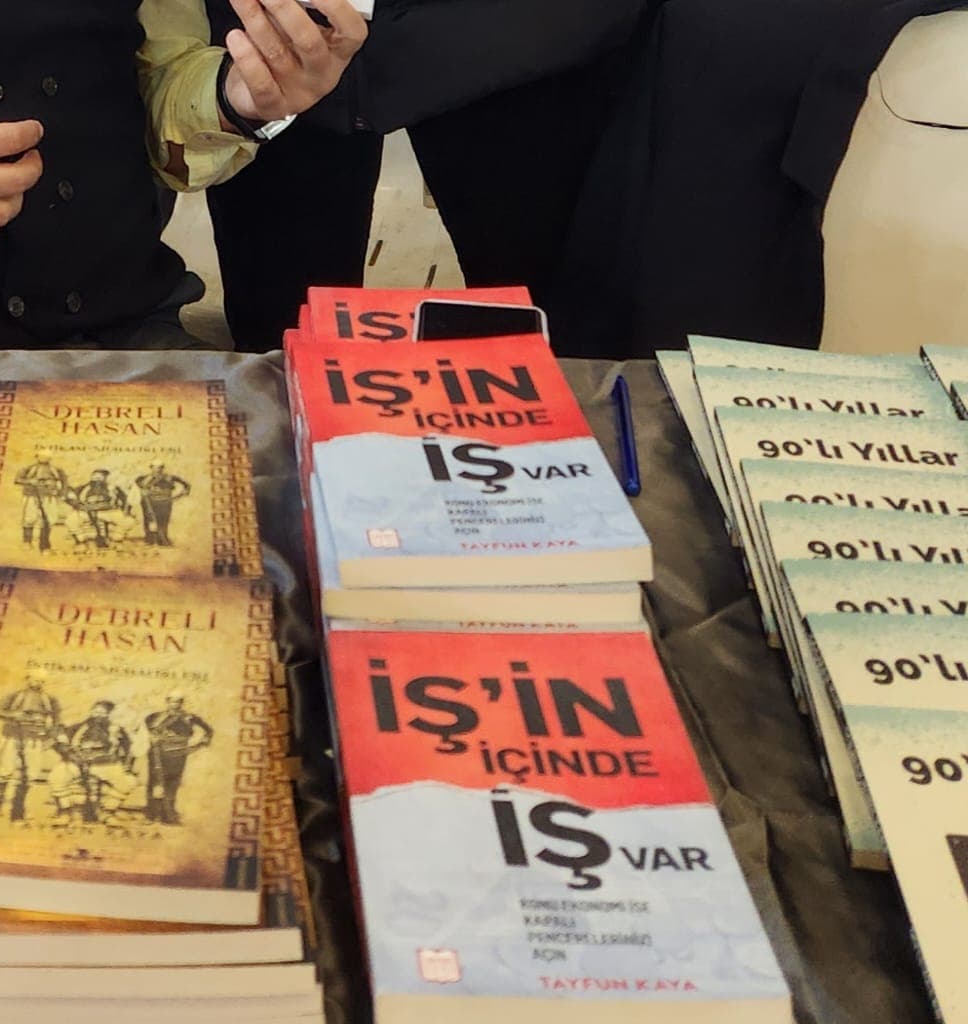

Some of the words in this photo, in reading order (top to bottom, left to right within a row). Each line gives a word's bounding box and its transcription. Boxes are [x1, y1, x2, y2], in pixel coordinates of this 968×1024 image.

[324, 358, 543, 417] İŞ'İN
[61, 421, 161, 436] HASAN
[414, 407, 553, 433] İÇİNDE
[422, 437, 515, 493] İŞ
[521, 463, 592, 479] VAR
[848, 440, 958, 467] Yıllar
[64, 627, 188, 653] HASAN
[367, 658, 645, 755] İŞ'İN
[478, 741, 659, 785] İÇİNDE
[490, 787, 612, 890] İŞ
[620, 845, 715, 872] VAR
[539, 976, 630, 991] TAYFUN
[635, 978, 699, 992] KAYA
